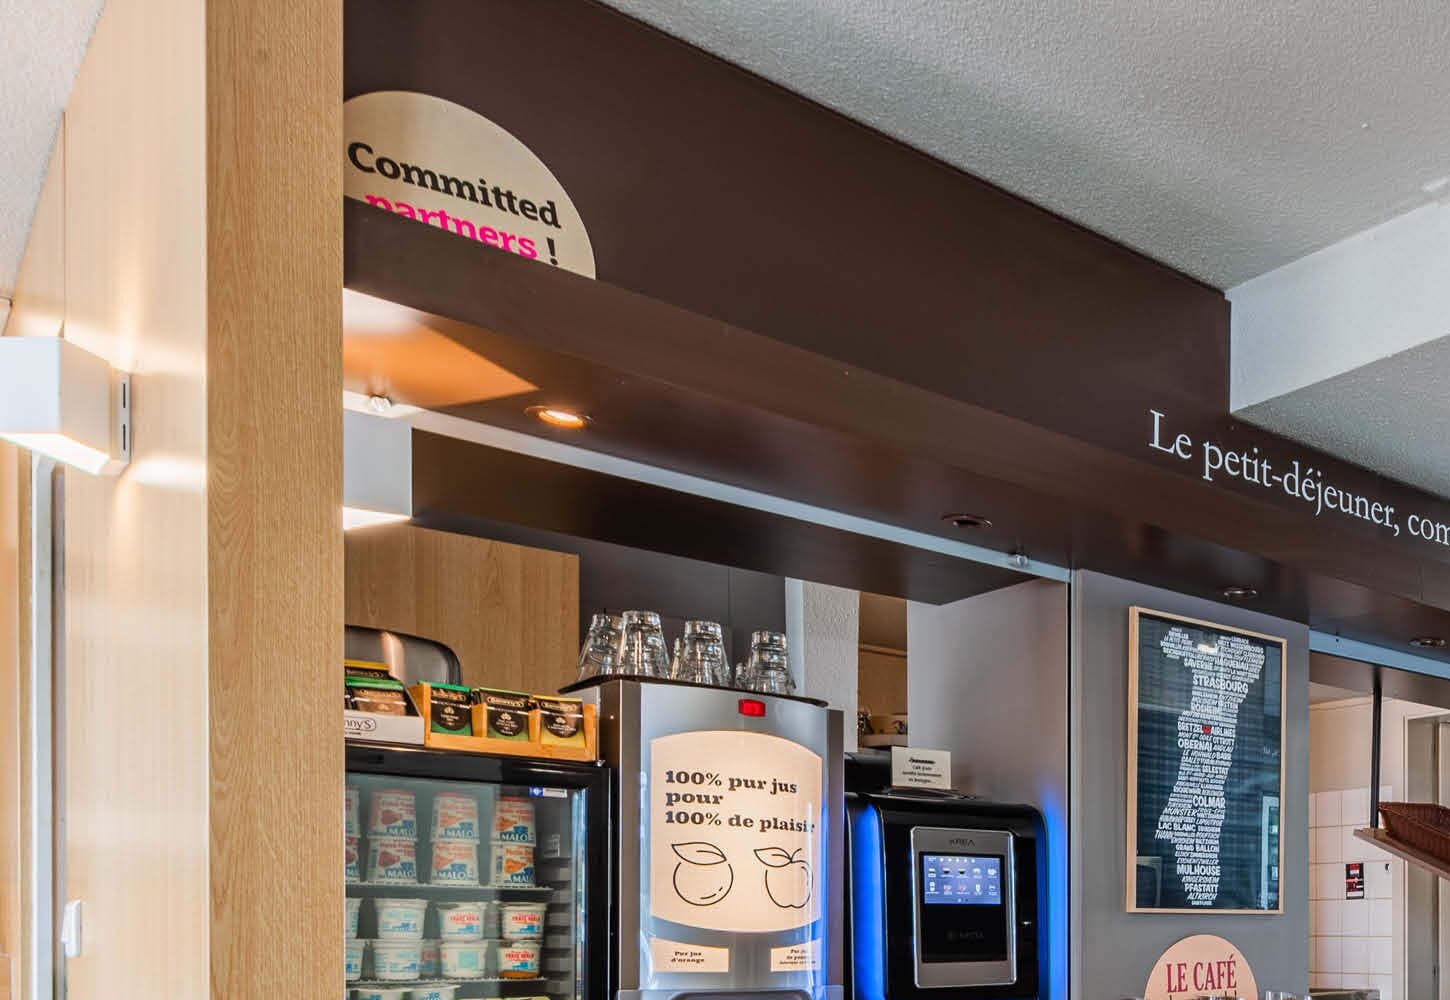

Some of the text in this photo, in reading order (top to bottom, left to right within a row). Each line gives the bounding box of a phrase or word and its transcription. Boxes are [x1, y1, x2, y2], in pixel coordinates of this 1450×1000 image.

[347, 141, 562, 229] Committed
[1148, 408, 1193, 460] Le
[1202, 441, 1401, 537] petit-déjeuner,
[1193, 673, 1249, 694] STRASBOURG
[1177, 738, 1213, 752] OBERNAI
[665, 770, 797, 795] 100% pur jus
[665, 792, 723, 806] pour
[1192, 795, 1226, 808] COLMAR
[665, 811, 722, 826] 100%
[728, 814, 754, 828] de
[1158, 822, 1196, 831] LAC BLANC
[501, 833, 528, 842] MALO
[437, 871, 468, 881] MALO
[1176, 864, 1221, 876] MULHOUSE
[1184, 883, 1219, 892] PFASTATT
[1166, 954, 1237, 993] LE CAFÉ
